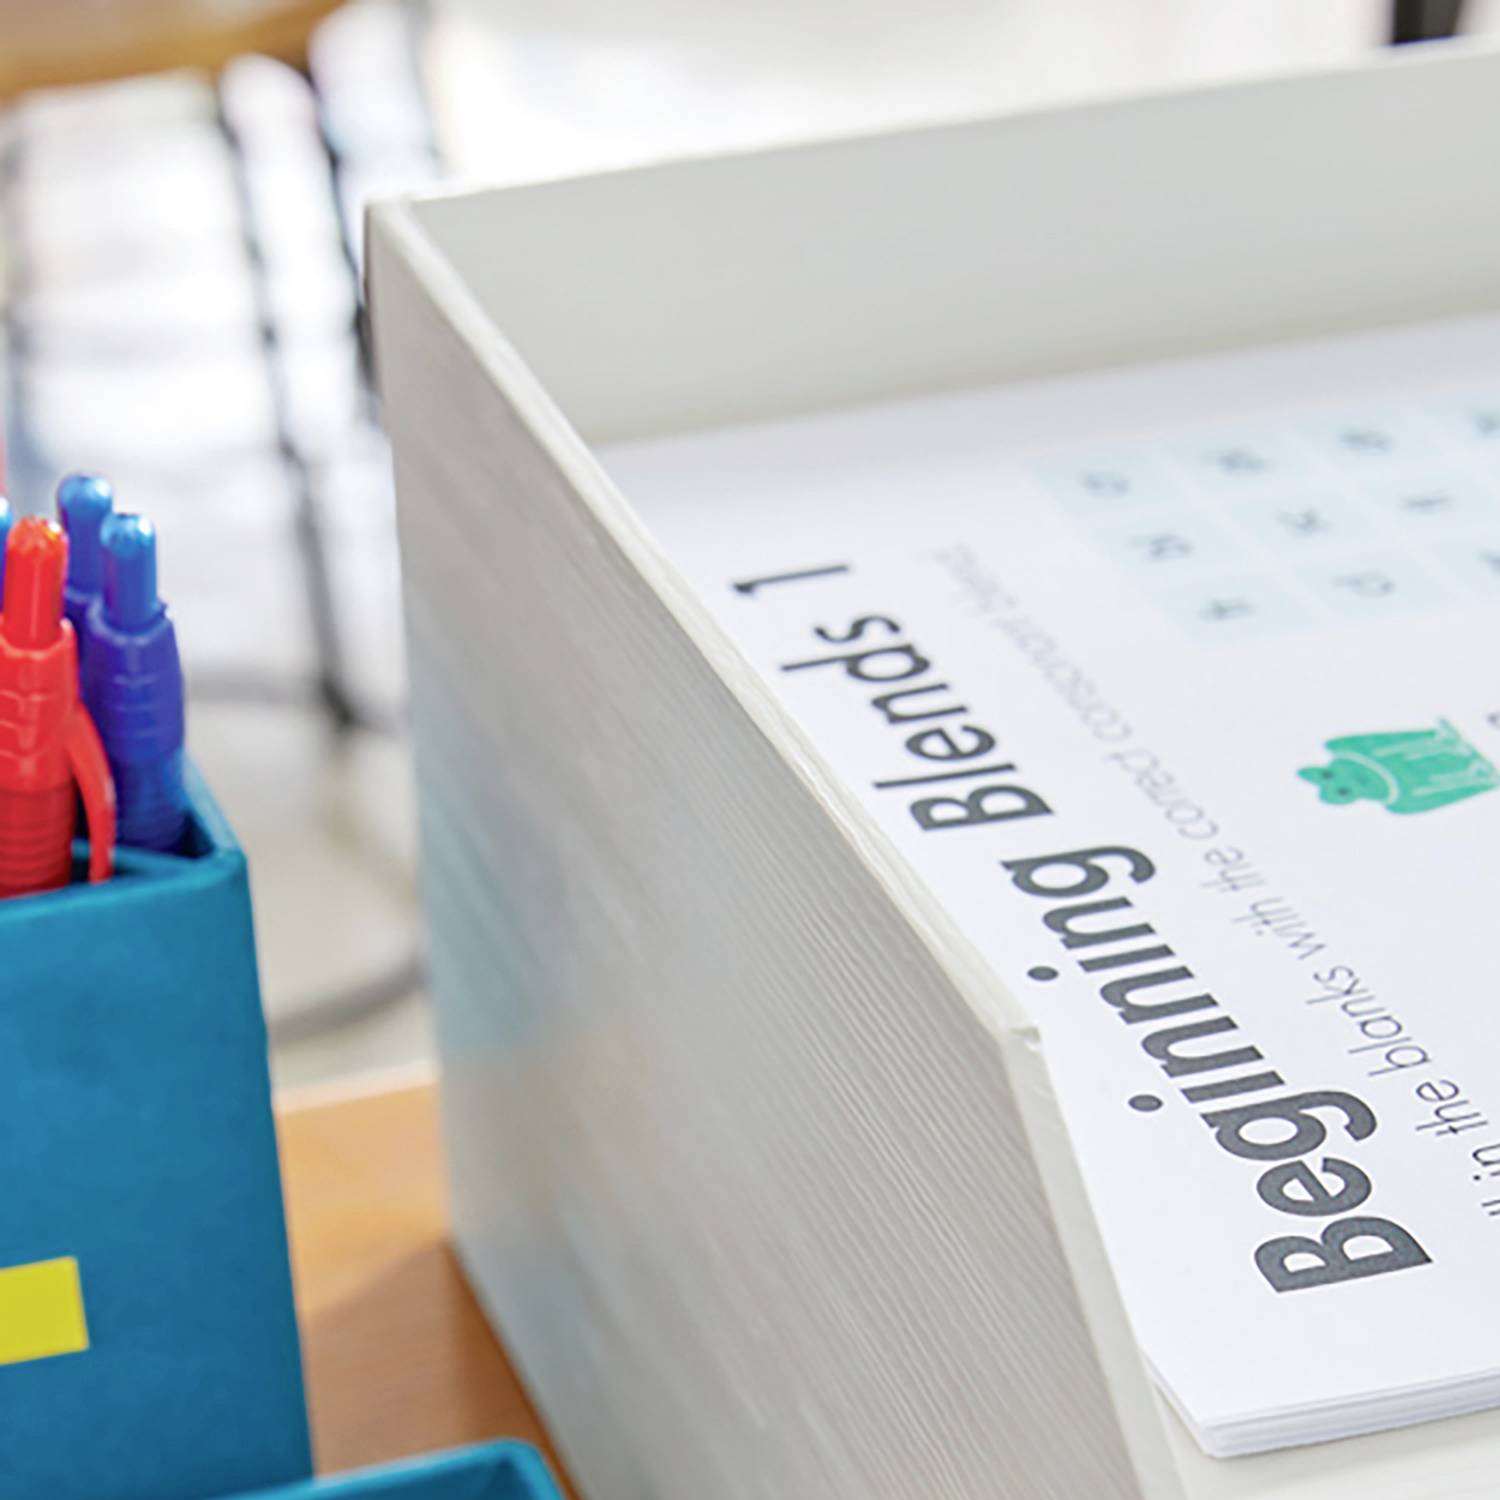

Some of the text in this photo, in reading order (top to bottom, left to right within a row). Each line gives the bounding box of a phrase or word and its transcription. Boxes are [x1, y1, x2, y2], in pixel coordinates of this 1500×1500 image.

[1200, 846, 1267, 892] the
[732, 564, 1433, 1293] Beginning Blends 1
[1231, 897, 1327, 960] with
[1306, 963, 1432, 1077] blanks
[1415, 1078, 1490, 1136] the
